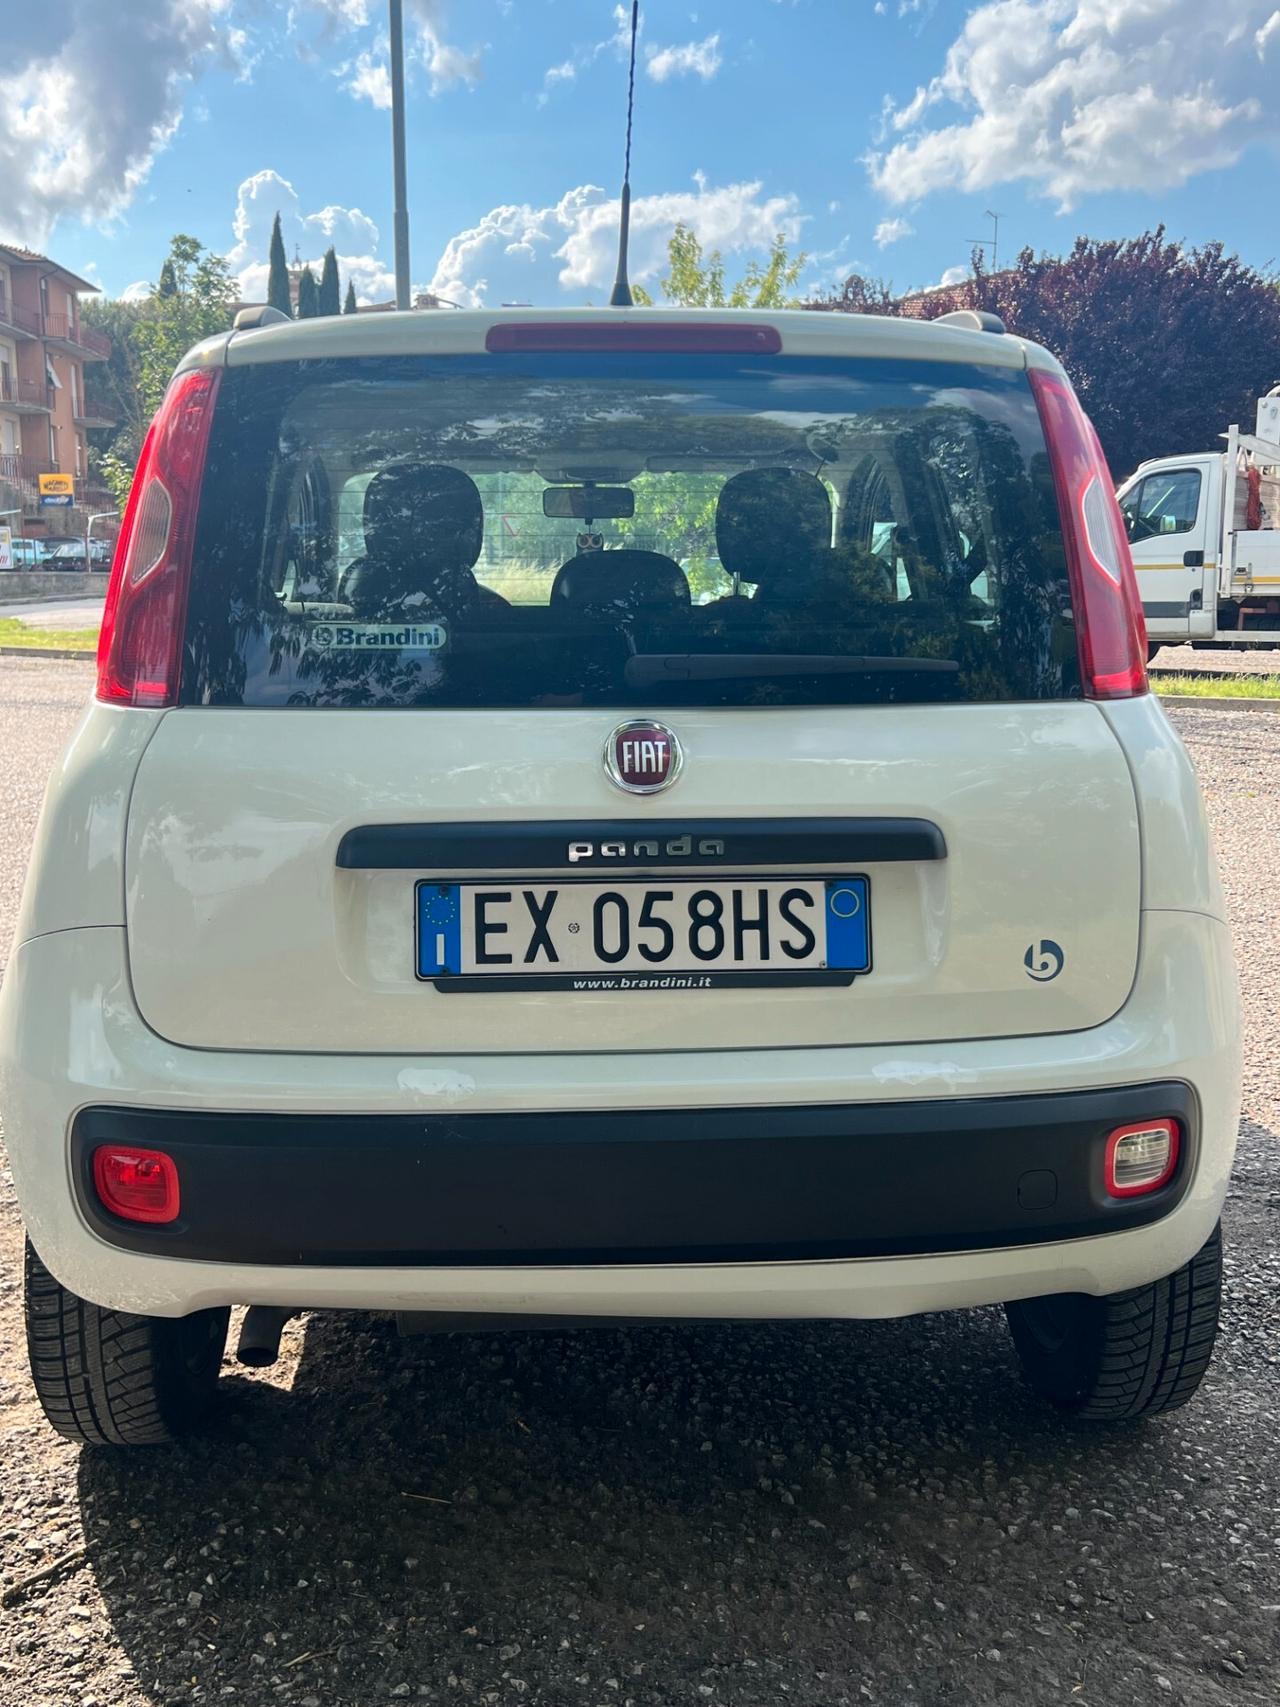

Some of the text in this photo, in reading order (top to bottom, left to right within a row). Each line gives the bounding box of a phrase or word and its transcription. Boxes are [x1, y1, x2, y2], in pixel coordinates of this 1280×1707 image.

[336, 627, 440, 645] Brandini
[622, 740, 667, 773] FIAT
[568, 834, 725, 862] panda
[474, 888, 816, 965] EX 058HS
[573, 977, 712, 989] www.brandini.it
